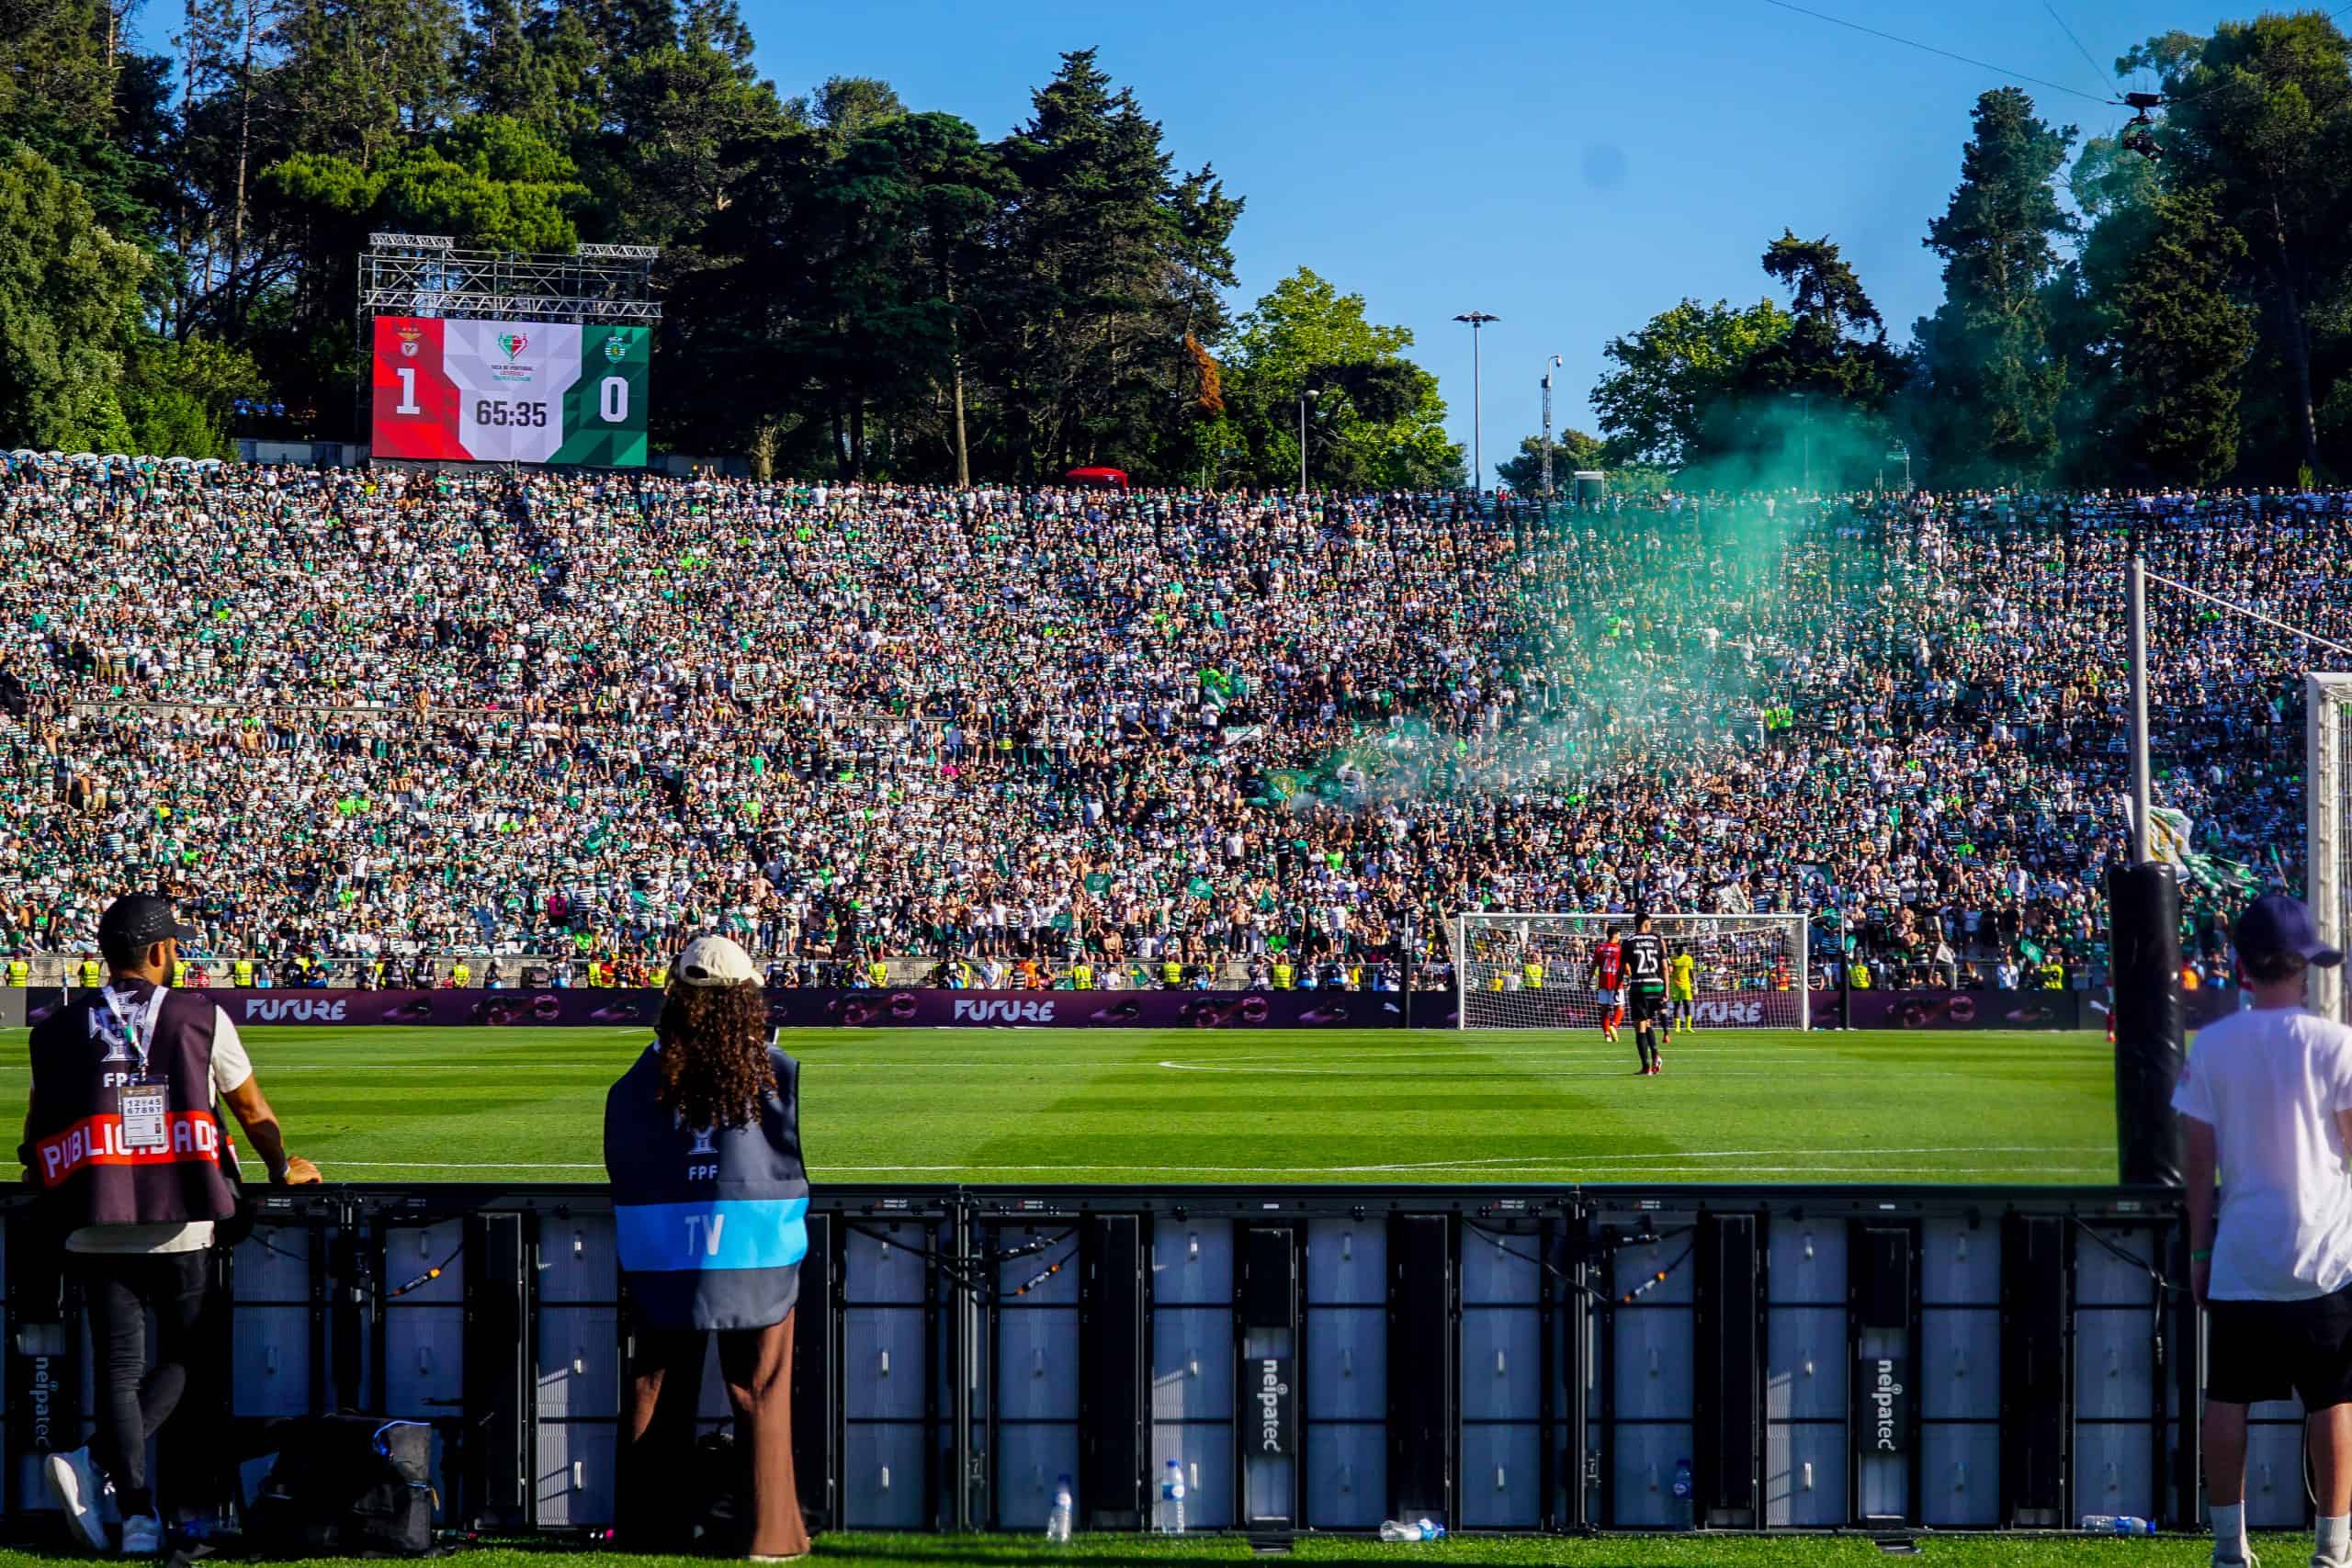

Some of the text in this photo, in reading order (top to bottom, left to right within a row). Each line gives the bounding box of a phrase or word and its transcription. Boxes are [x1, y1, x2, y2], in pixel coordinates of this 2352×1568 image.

[396, 367, 421, 415] 1
[600, 377, 629, 423] 0
[476, 400, 547, 428] 65:35
[1633, 949, 1658, 974] 25
[245, 998, 346, 1021] FUTURE
[955, 999, 1055, 1022] FUTURE
[103, 1072, 141, 1088] FPF
[43, 1120, 219, 1179] PUBLICADE
[688, 1165, 718, 1181] FPF
[684, 1213, 725, 1256] TV
